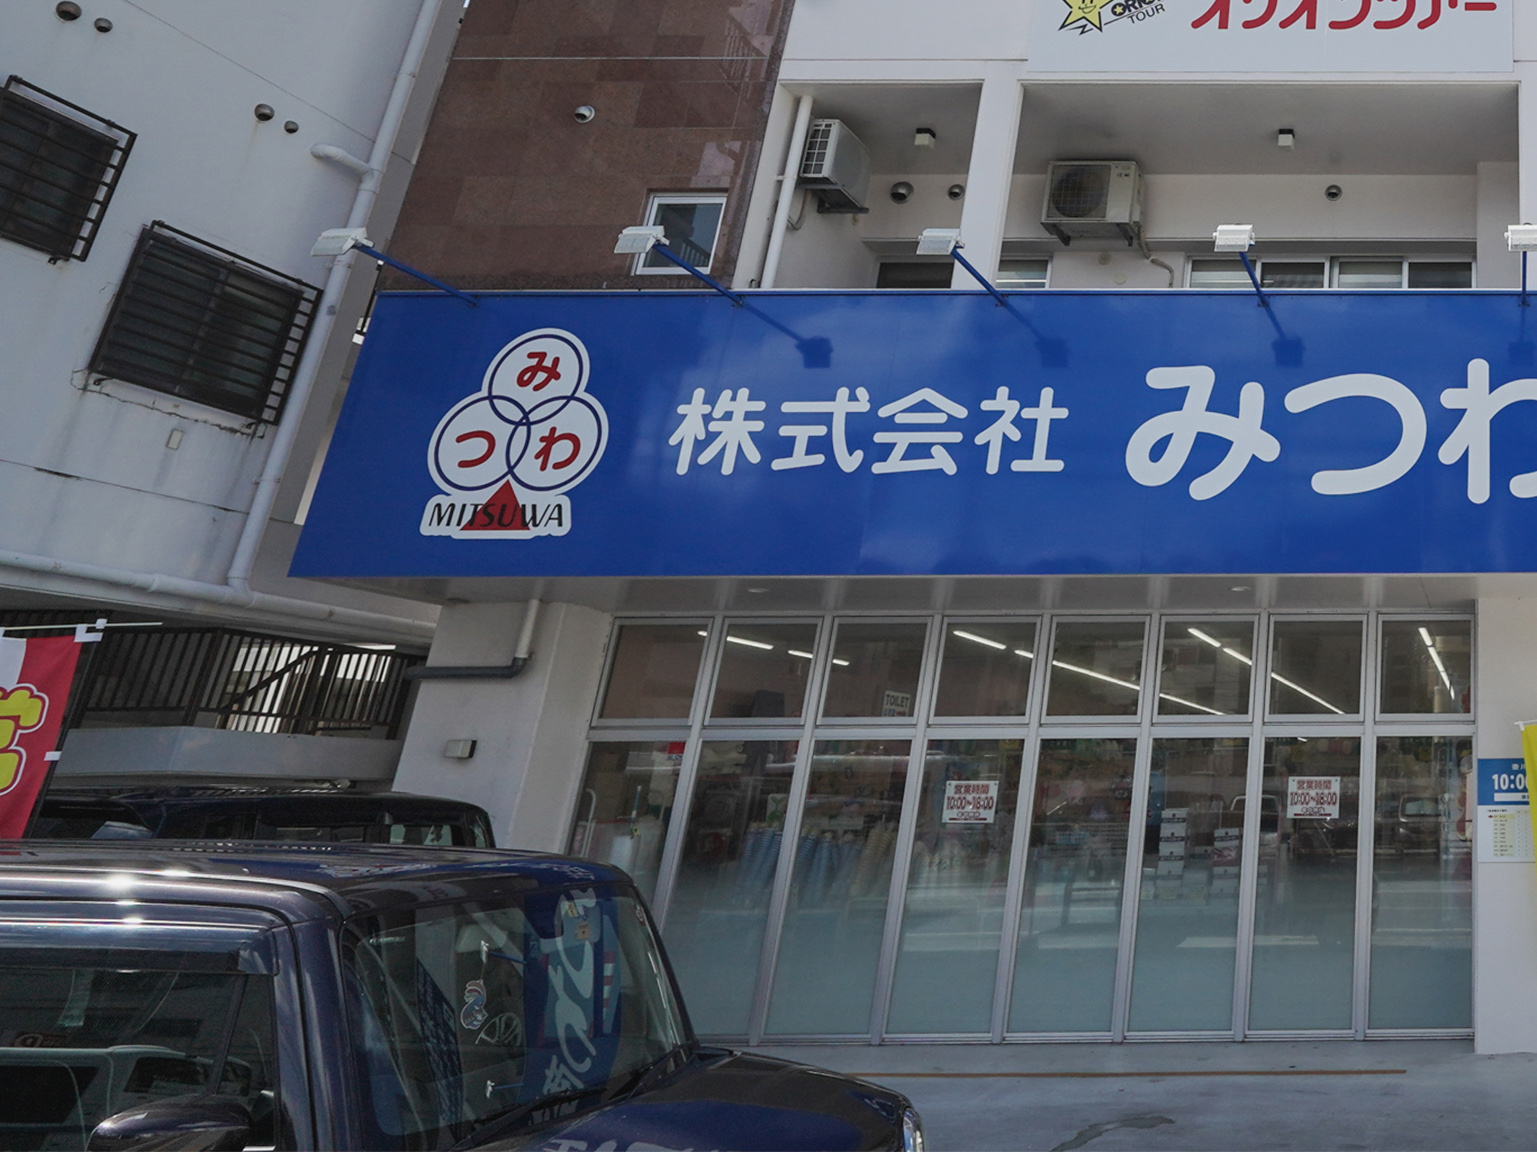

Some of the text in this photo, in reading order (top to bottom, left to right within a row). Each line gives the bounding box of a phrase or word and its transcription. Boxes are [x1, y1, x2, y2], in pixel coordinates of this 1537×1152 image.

[1127, 3, 1166, 24] TOUR
[668, 386, 1069, 476] 株式会社
[428, 502, 564, 529] MITSUWA
[1492, 773, 1528, 790] 10:0
